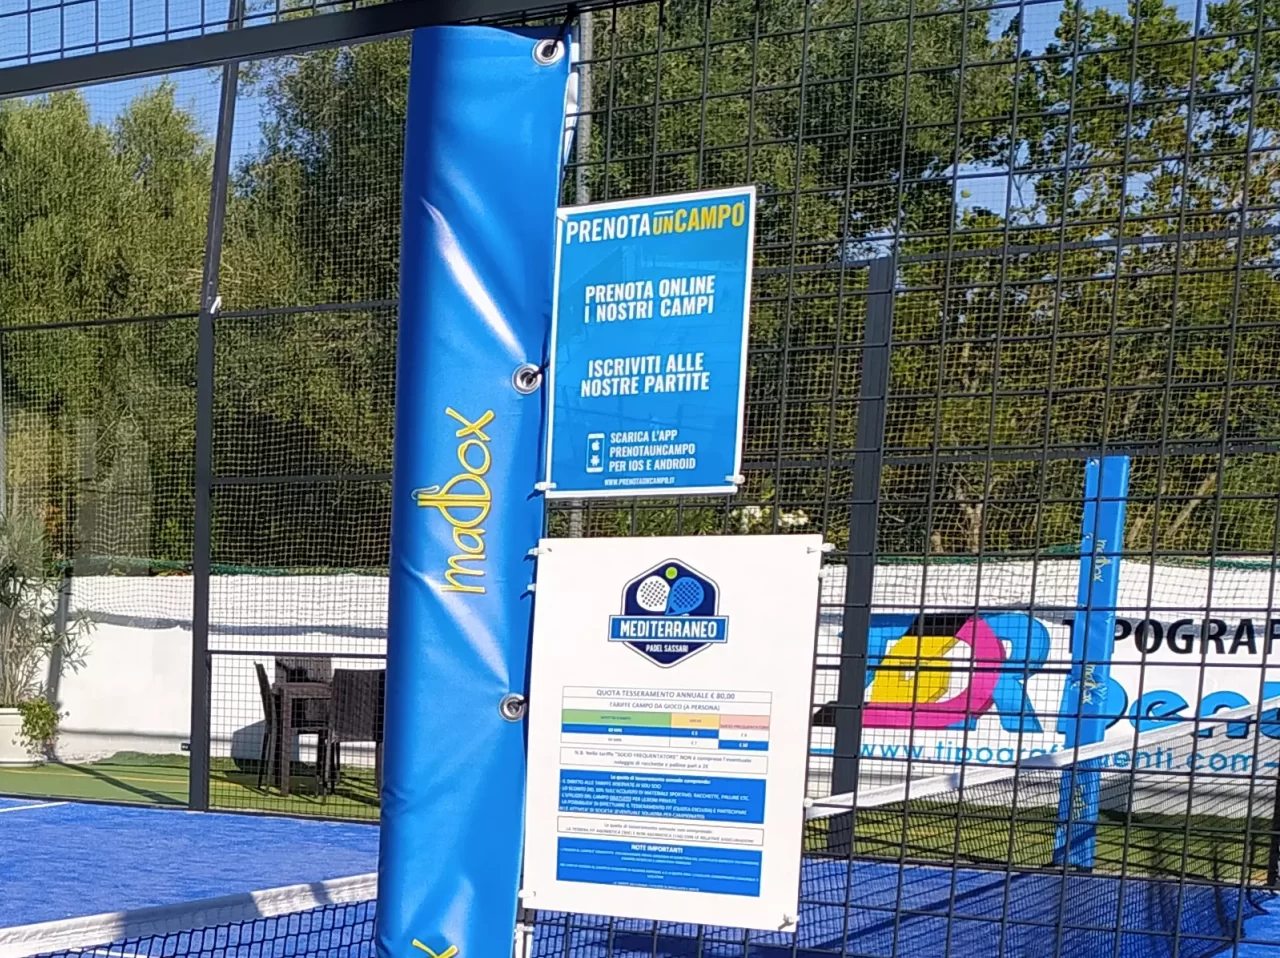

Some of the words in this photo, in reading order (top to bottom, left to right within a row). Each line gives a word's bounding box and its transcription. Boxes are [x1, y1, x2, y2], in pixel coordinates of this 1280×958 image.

[585, 280, 654, 304] PRENOTA
[659, 275, 716, 297] ONLINE
[584, 305, 590, 323] I
[596, 300, 653, 322] NOSTRI
[660, 295, 714, 317] CAMPI
[588, 355, 661, 378] ISCRIVITI
[665, 352, 704, 373] ALLE
[581, 376, 640, 397] NOSTRE
[644, 372, 710, 393] PARTITE
[610, 431, 649, 444] SCARICA
[651, 429, 678, 442] L'APP
[609, 443, 696, 458] PRENOTAUNCAMPO
[608, 460, 626, 472] PER
[628, 460, 644, 471] IOS
[646, 459, 652, 471] E
[653, 458, 696, 470] ANDROID
[411, 407, 495, 593] madbox
[620, 620, 718, 638] MEDITERRANEO
